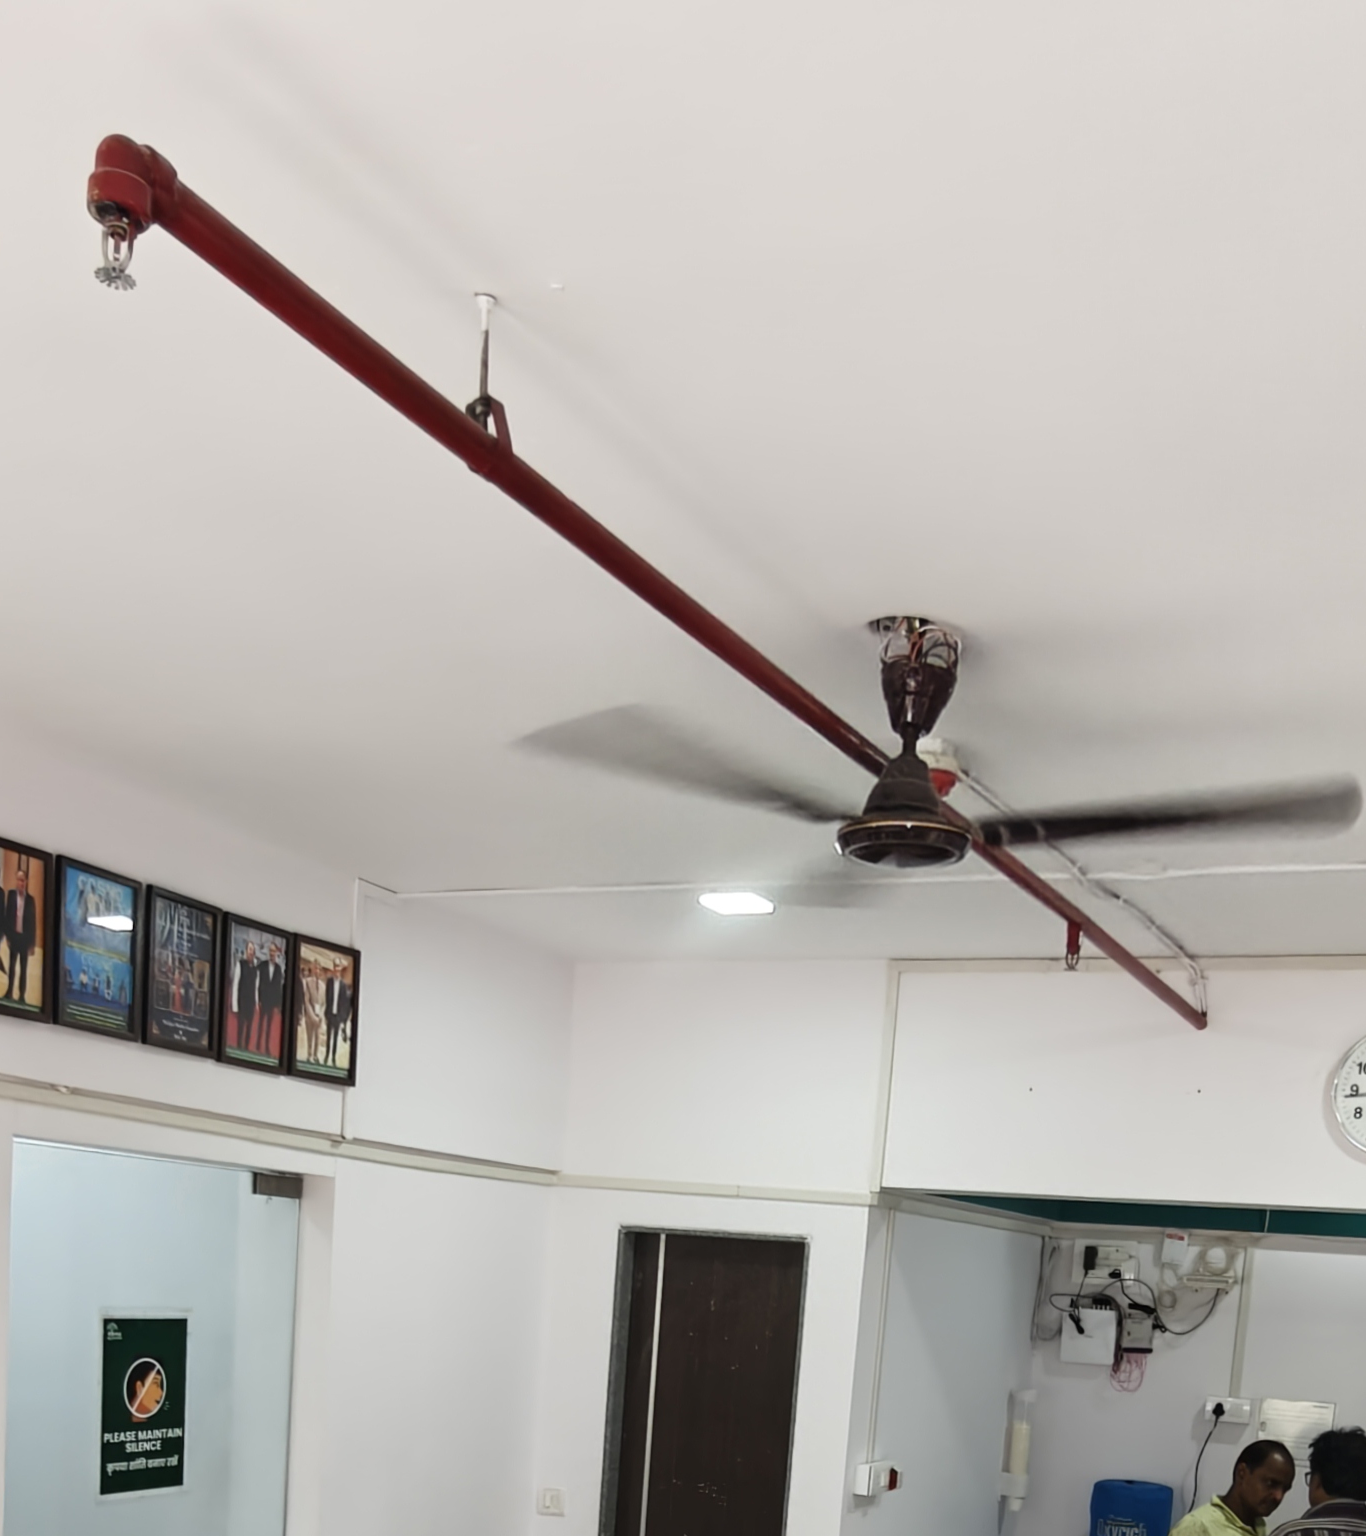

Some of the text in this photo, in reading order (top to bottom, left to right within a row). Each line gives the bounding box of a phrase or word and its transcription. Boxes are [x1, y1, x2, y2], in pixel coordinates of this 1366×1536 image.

[1350, 1084, 1359, 1097] 9
[1353, 1107, 1363, 1120] 8
[103, 1428, 183, 1443] PLEASE MAINTAIN
[125, 1440, 161, 1453] SILENCE
